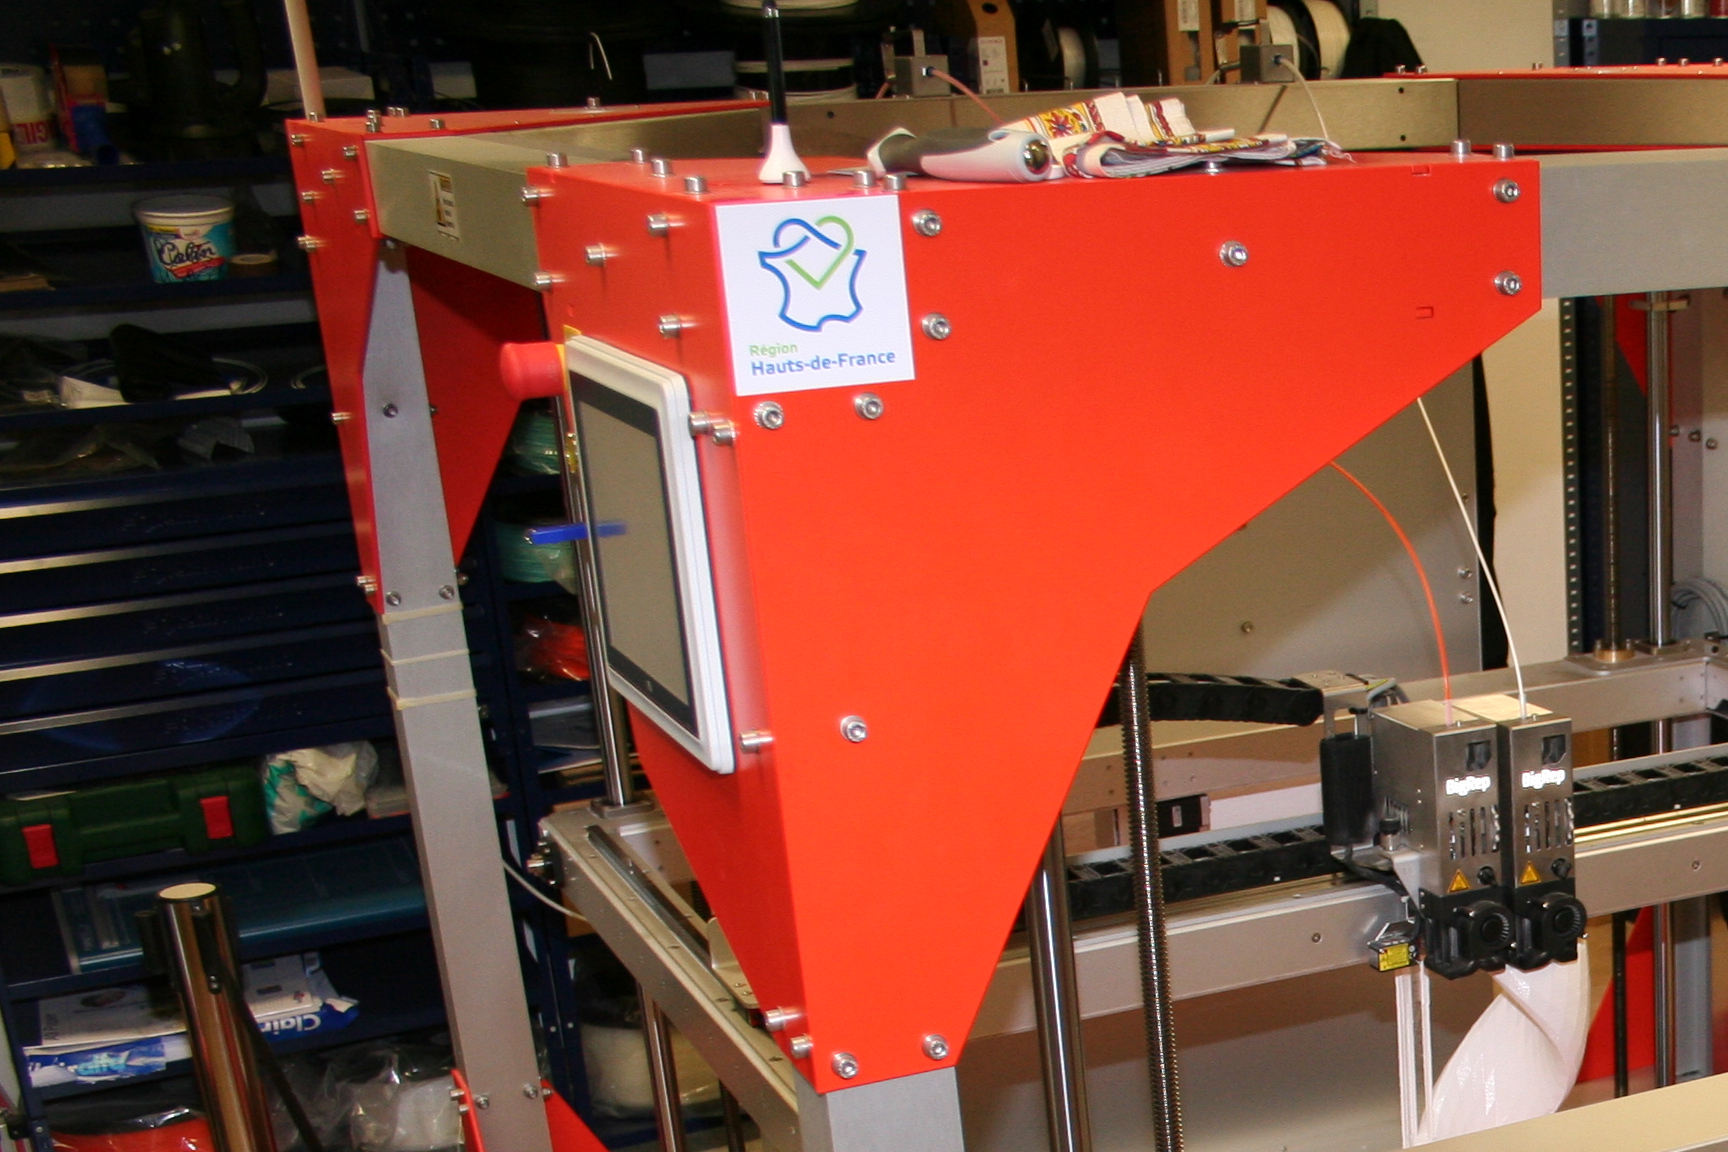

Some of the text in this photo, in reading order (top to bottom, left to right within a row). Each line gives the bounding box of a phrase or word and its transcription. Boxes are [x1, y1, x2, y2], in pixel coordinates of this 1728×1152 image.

[749, 343, 799, 358] Région
[751, 351, 897, 376] Hauts-de-France
[1446, 776, 1490, 796] BigRep
[1522, 769, 1565, 789] BigRep
